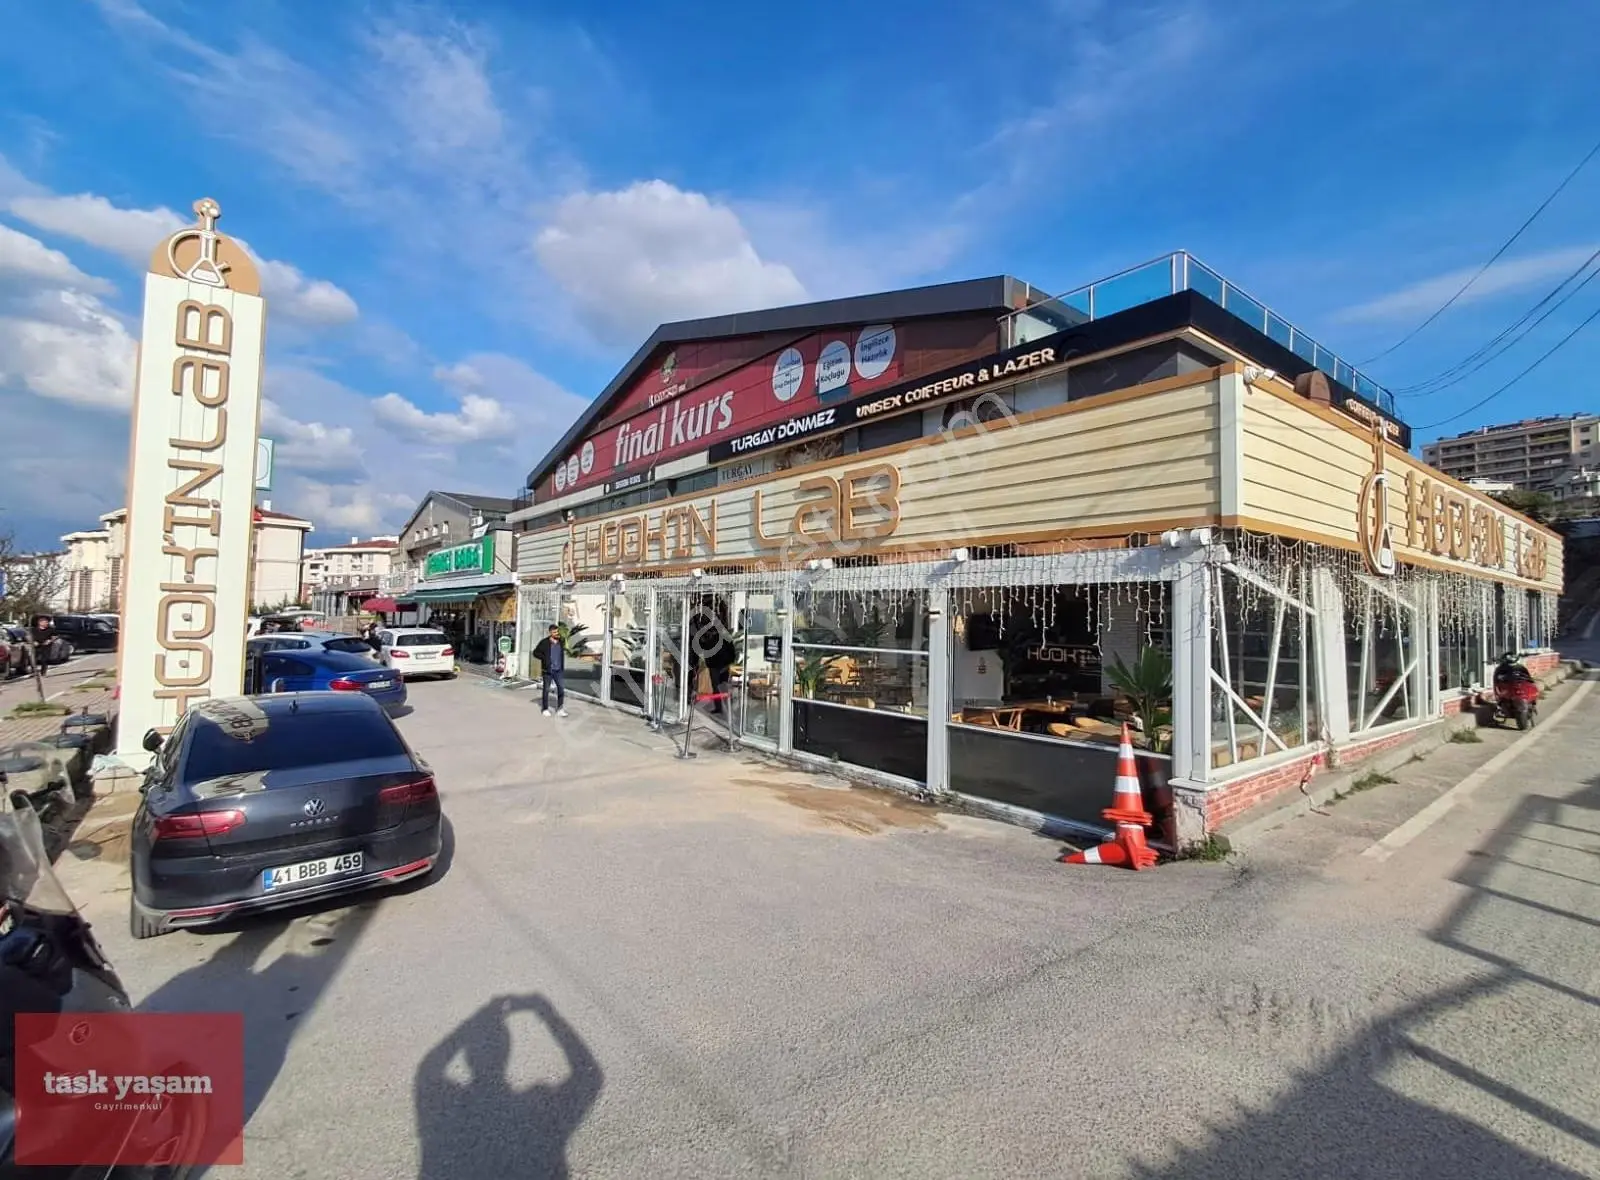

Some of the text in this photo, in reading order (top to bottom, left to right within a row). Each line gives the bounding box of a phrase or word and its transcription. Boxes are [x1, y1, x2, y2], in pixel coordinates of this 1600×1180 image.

[614, 406, 668, 466] final
[669, 390, 735, 447] kurs
[730, 347, 1056, 453] TURGAY DÖNMEZ UNISEX COIFFEUR & LAZER
[272, 867, 292, 884] 41
[298, 861, 328, 879] BBB
[334, 854, 361, 872] 459
